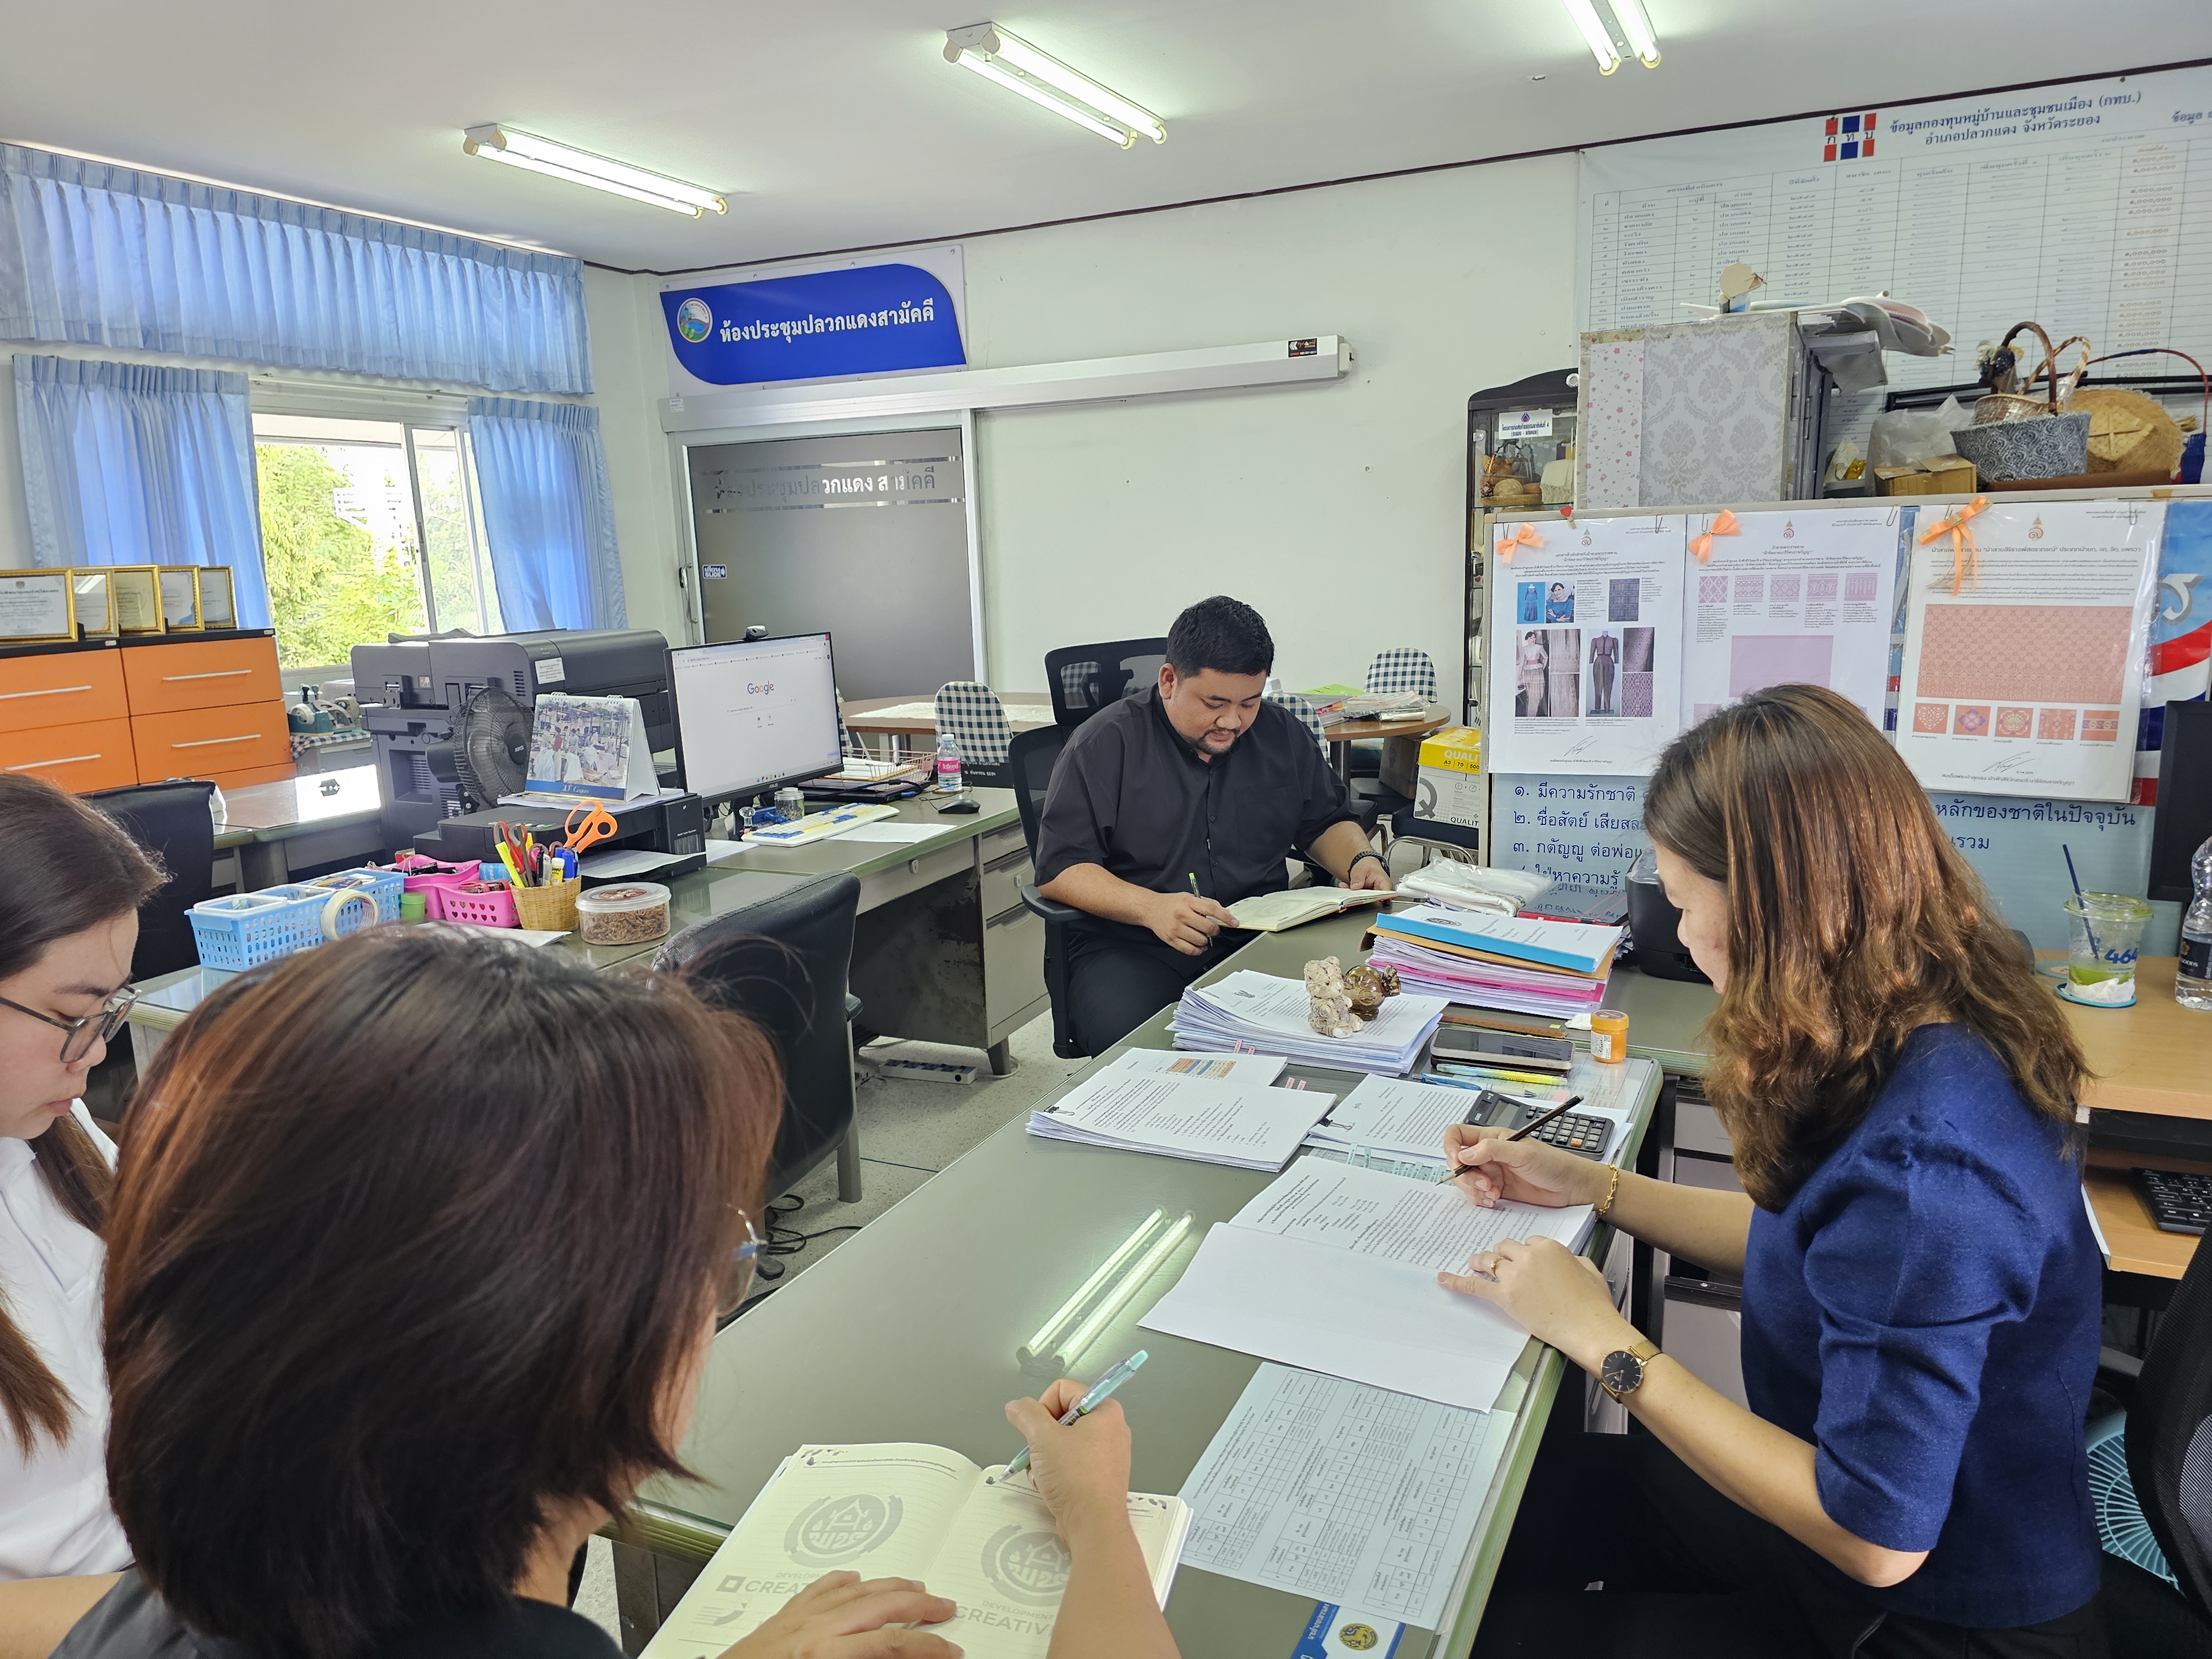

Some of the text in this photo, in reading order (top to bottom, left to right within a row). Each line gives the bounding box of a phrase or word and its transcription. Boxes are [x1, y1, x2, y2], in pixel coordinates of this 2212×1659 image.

[1890, 91, 2142, 134] ข้อมูลกองทุนหมู่บ้านและชุมชนเมือง (กทบ.)
[1865, 131, 1873, 139] บ
[1925, 114, 2100, 146] อำเภอปลวกแดง จังหวัดระยอง
[720, 298, 933, 345] ห้องประชุมปลวกแดงสามัคคี
[747, 681, 774, 695] Google
[1515, 781, 1635, 801] ๑. มีความรักชาติ
[1451, 817, 1479, 827] QUALIT
[1514, 811, 1530, 825] ๒.
[1537, 806, 1590, 828] ซื่อสัตย์
[1514, 838, 1642, 862] ๓. กตัญญู ต่อพ่อแ
[953, 1606, 1051, 1636] CREATIV
[982, 1600, 1055, 1620] DEVELOPMENT
